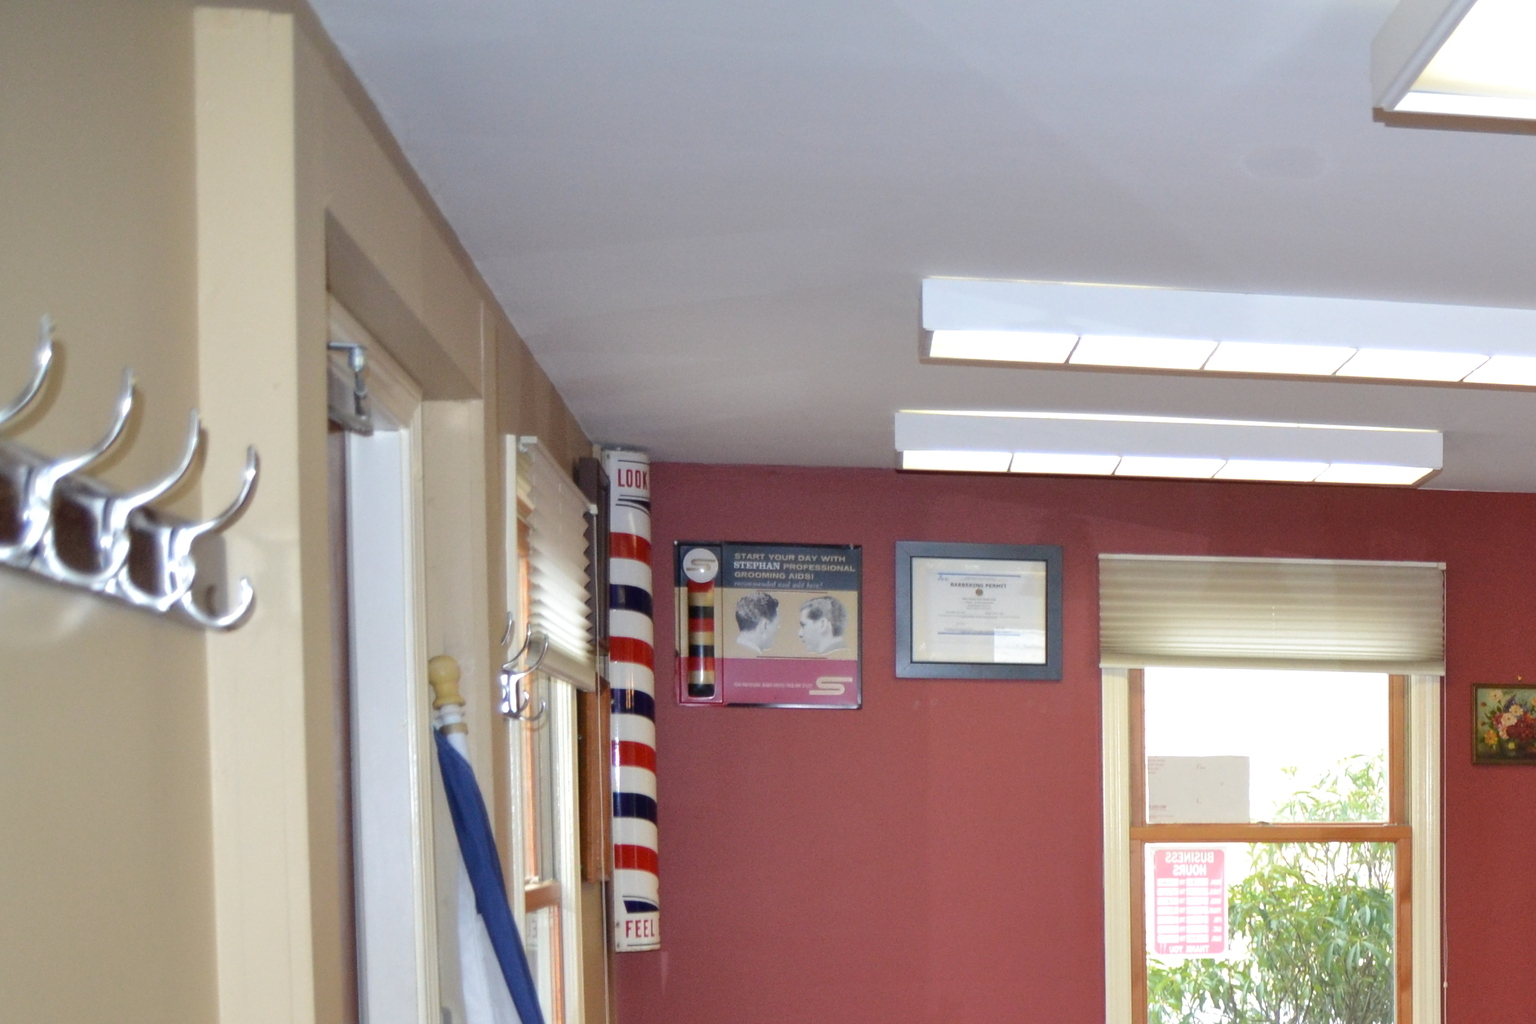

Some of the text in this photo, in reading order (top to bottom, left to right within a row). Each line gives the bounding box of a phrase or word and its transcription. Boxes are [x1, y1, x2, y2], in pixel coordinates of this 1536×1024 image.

[617, 469, 648, 490] LOOK
[734, 552, 846, 563] START YOUR DAY WITH
[733, 561, 856, 572] STEPHAN PROFESSIONAL
[734, 571, 786, 580] GROOMING
[625, 919, 655, 938] FEEL
